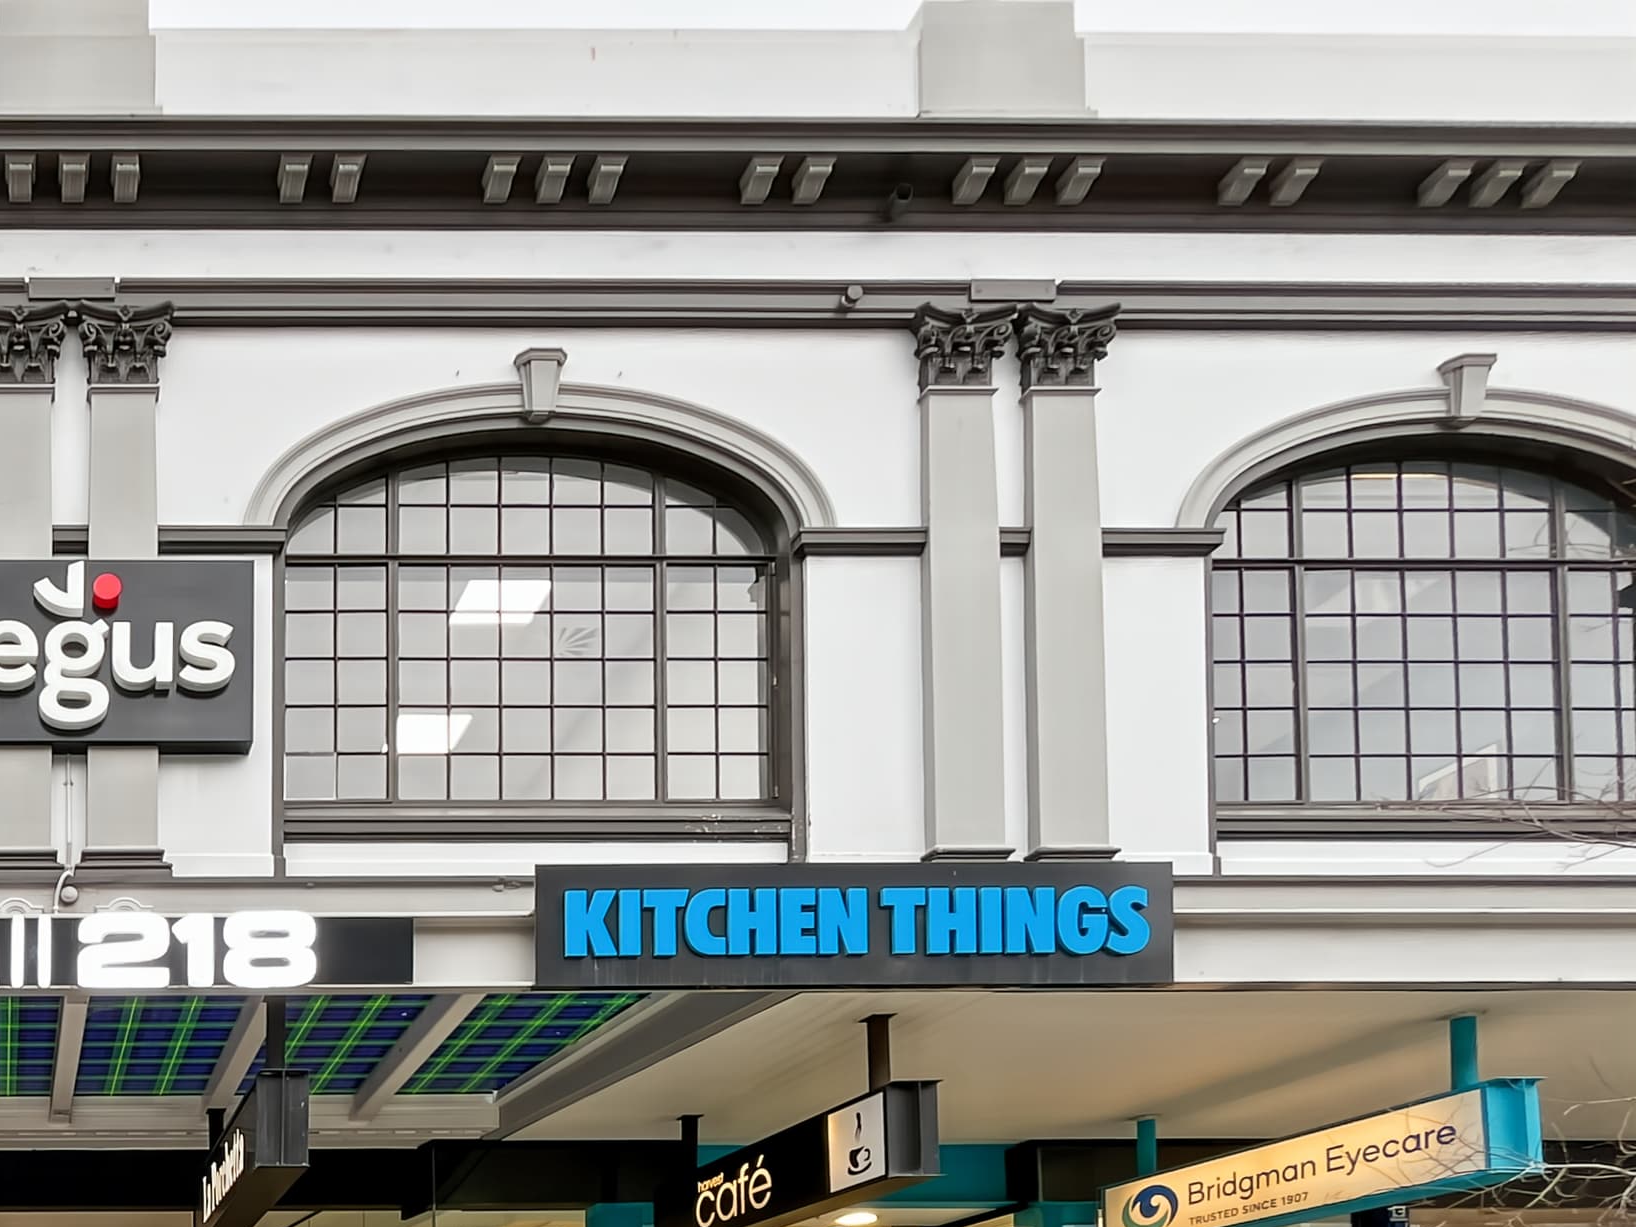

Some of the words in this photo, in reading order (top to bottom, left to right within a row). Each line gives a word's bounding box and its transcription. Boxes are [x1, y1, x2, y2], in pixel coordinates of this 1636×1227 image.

[76, 910, 318, 988] 218
[563, 887, 868, 958] KITCHEN
[879, 885, 1151, 957] THINGS
[696, 1154, 772, 1227] café
[1187, 1158, 1317, 1205] Bridgman
[1325, 1124, 1457, 1176] Eyecare
[1189, 1207, 1239, 1227] TRUSTED
[1242, 1199, 1277, 1216] SINCE
[1281, 1191, 1309, 1208] 1907
